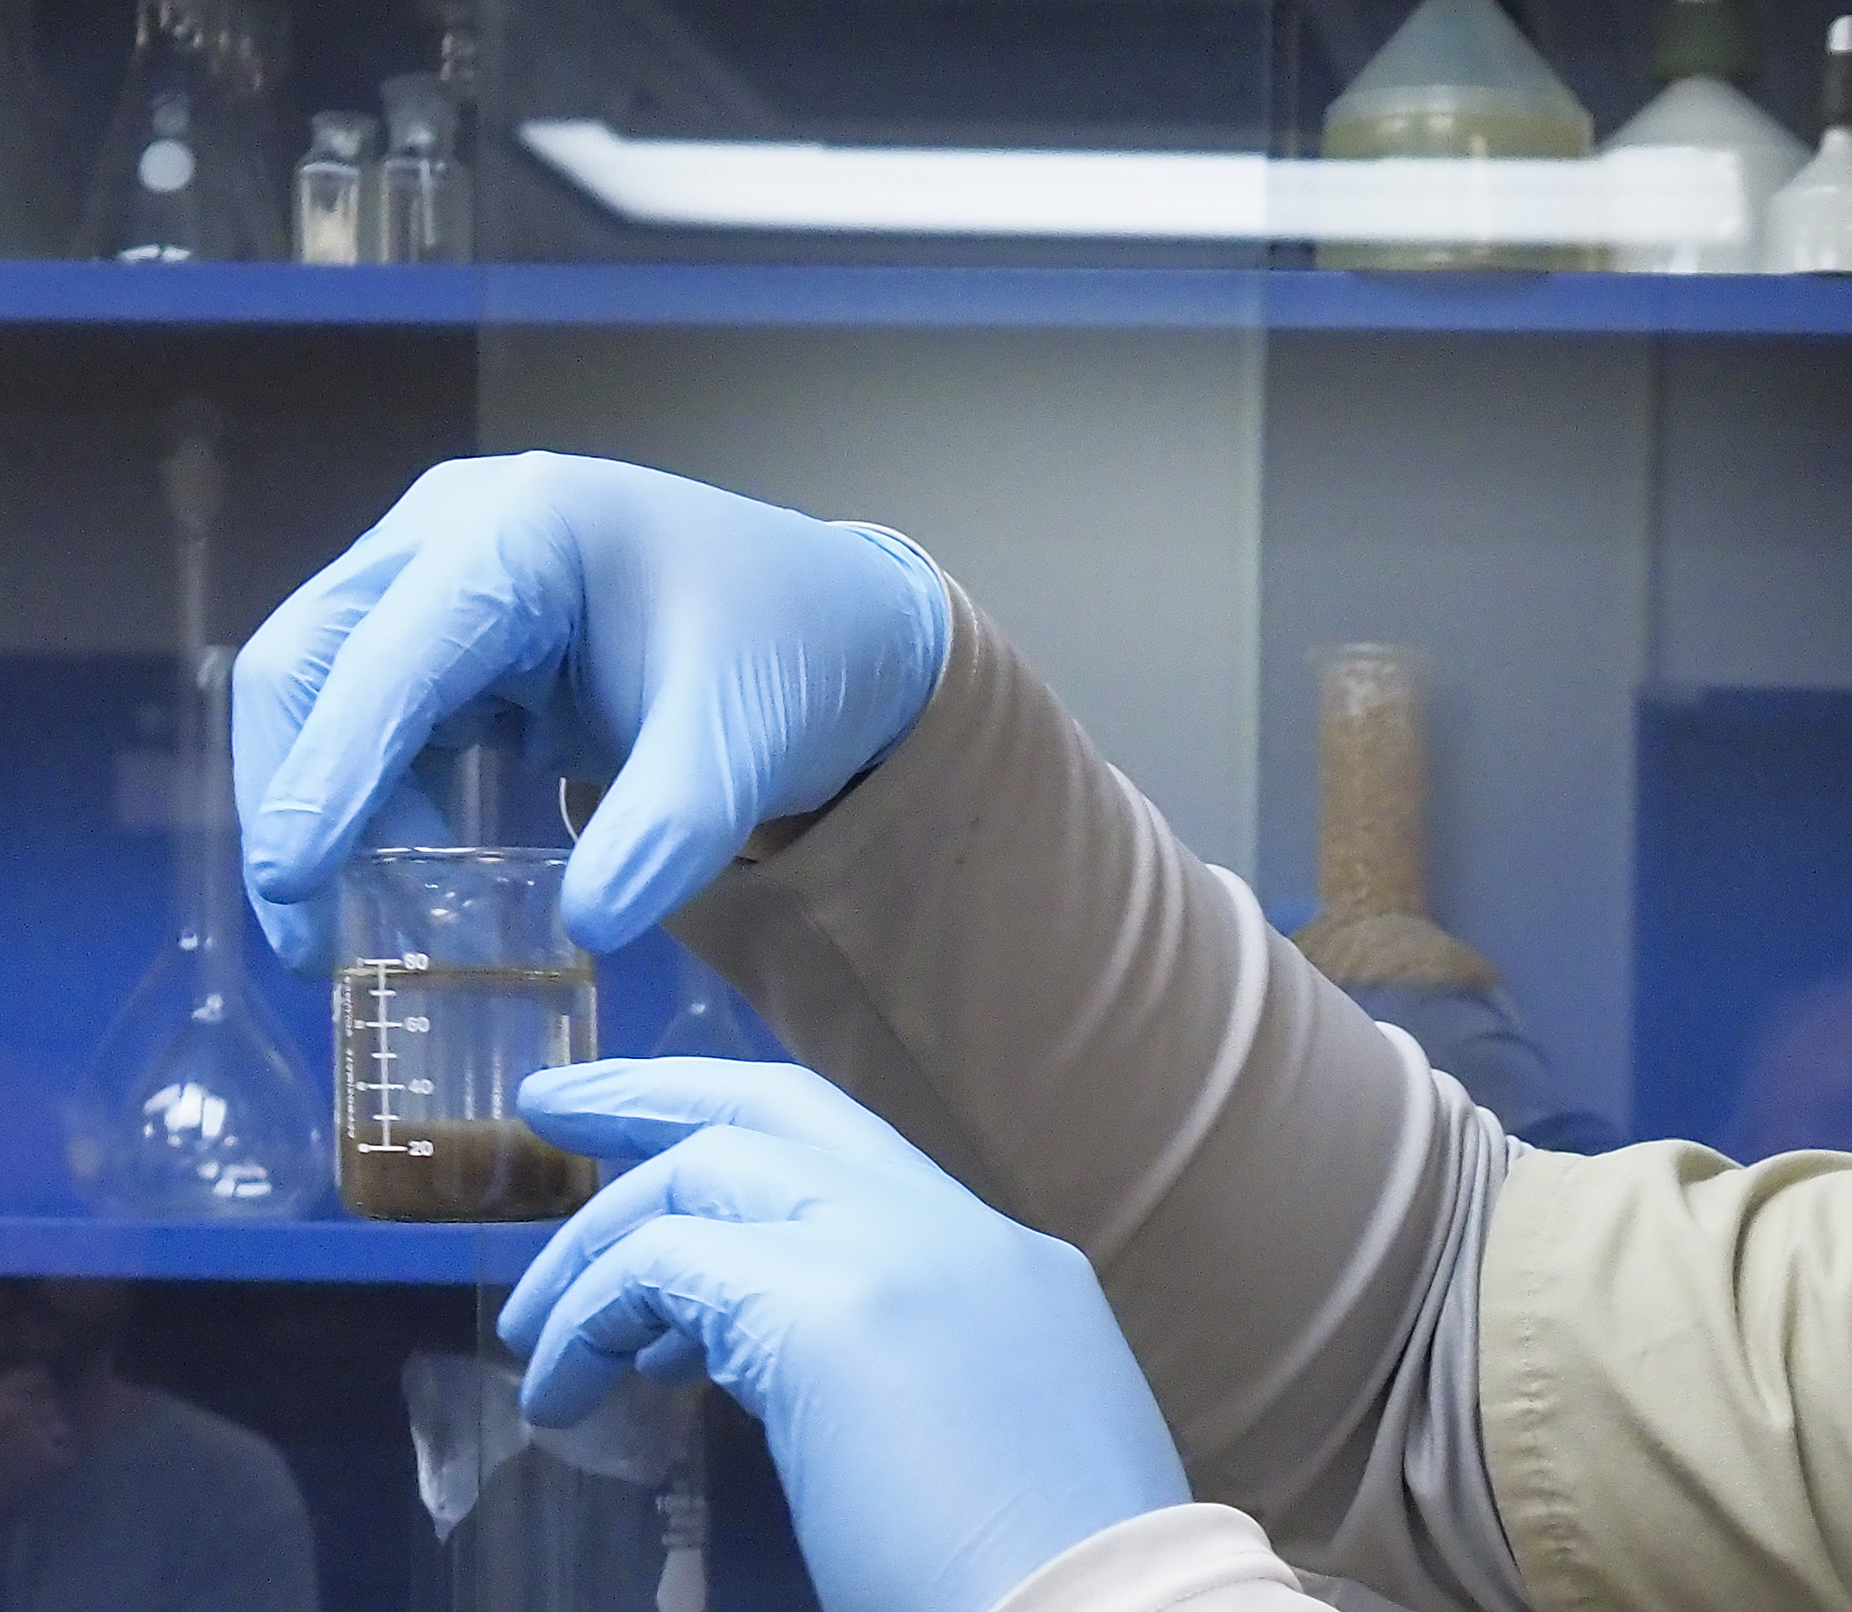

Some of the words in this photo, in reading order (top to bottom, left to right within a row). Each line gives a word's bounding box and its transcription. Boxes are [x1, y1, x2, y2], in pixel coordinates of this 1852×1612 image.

[404, 953, 429, 970] 80
[404, 1016, 430, 1033] 60
[409, 1079, 434, 1095] 40
[407, 1140, 435, 1156] 20
